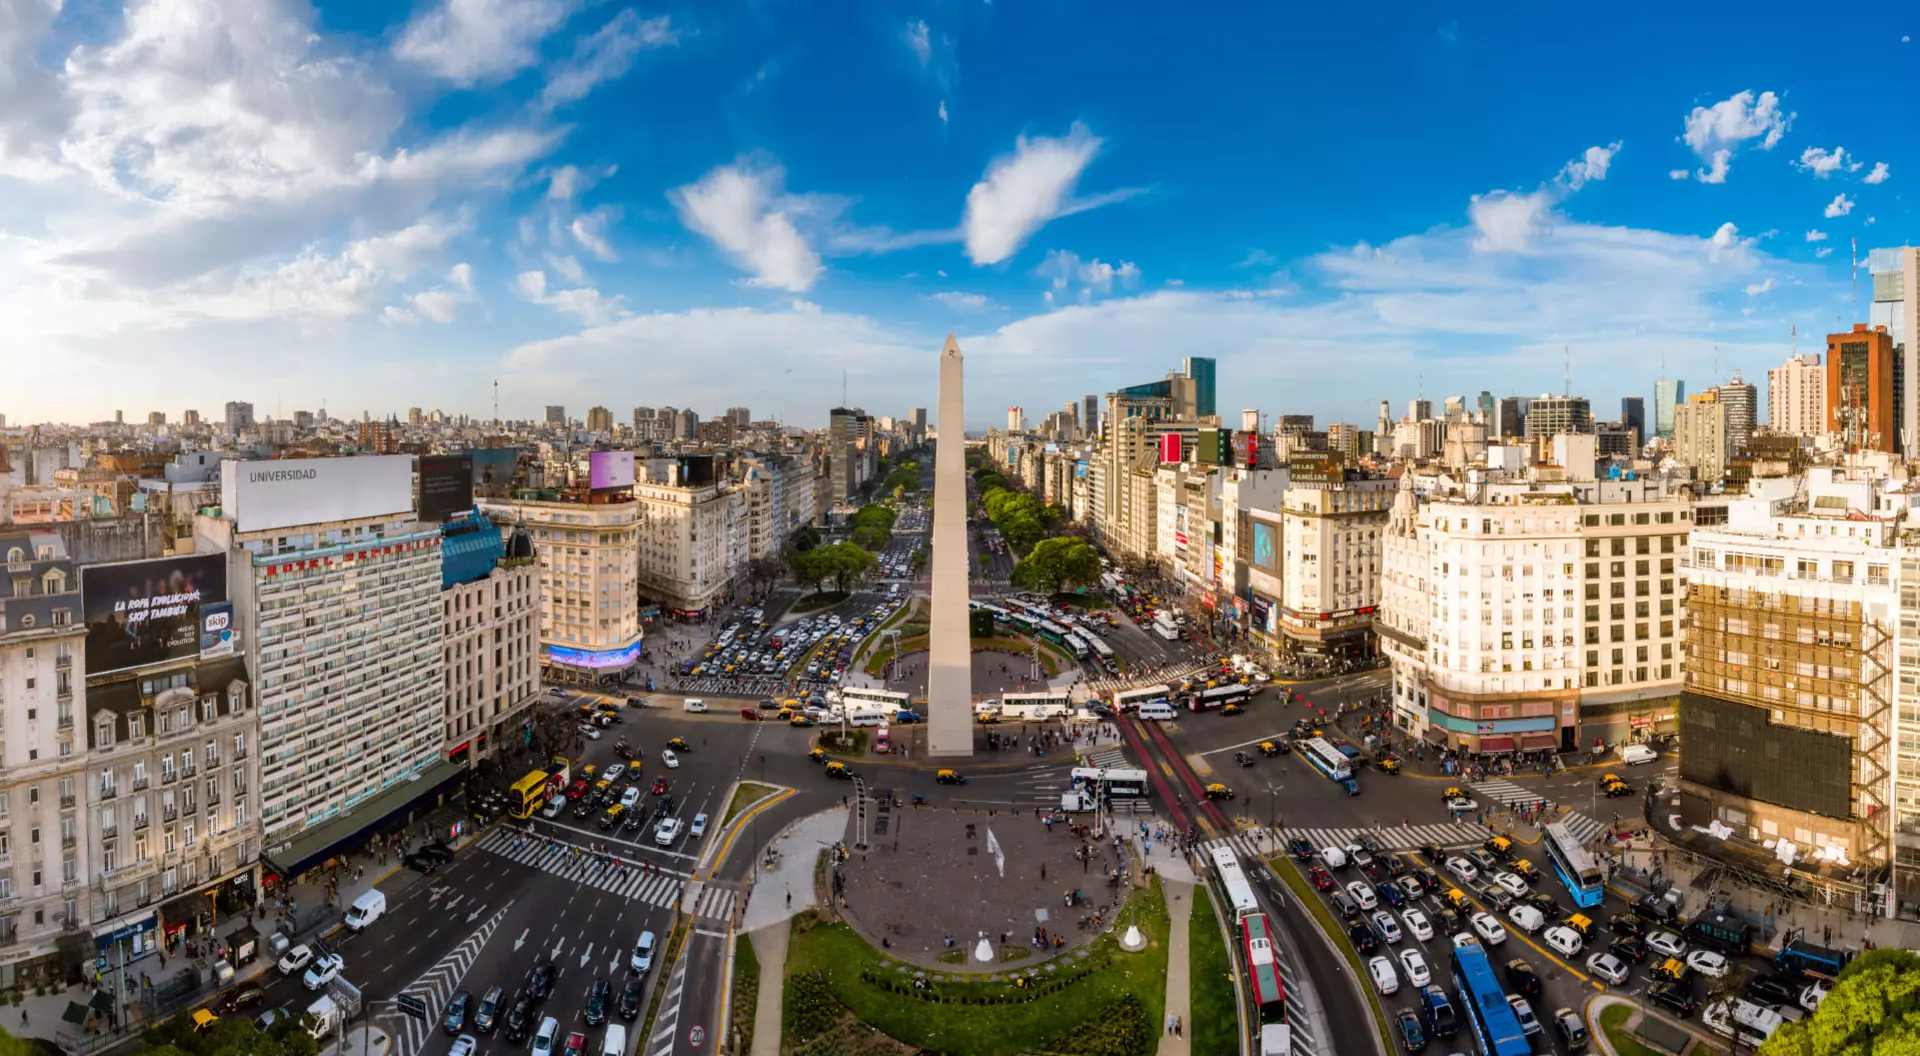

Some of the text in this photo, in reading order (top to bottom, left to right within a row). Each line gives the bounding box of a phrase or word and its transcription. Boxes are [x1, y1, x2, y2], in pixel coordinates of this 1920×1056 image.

[250, 469, 317, 483] UNIVERSIDAD
[267, 557, 333, 576] HOTEL
[114, 600, 126, 612] LA
[127, 598, 150, 610] ROPA
[128, 604, 188, 623] SKIP TAMBIÉN
[208, 616, 226, 627] skip
[177, 625, 195, 633] NUEVO
[167, 637, 195, 648] EVOLUTION
[692, 1029, 703, 1043] 20
